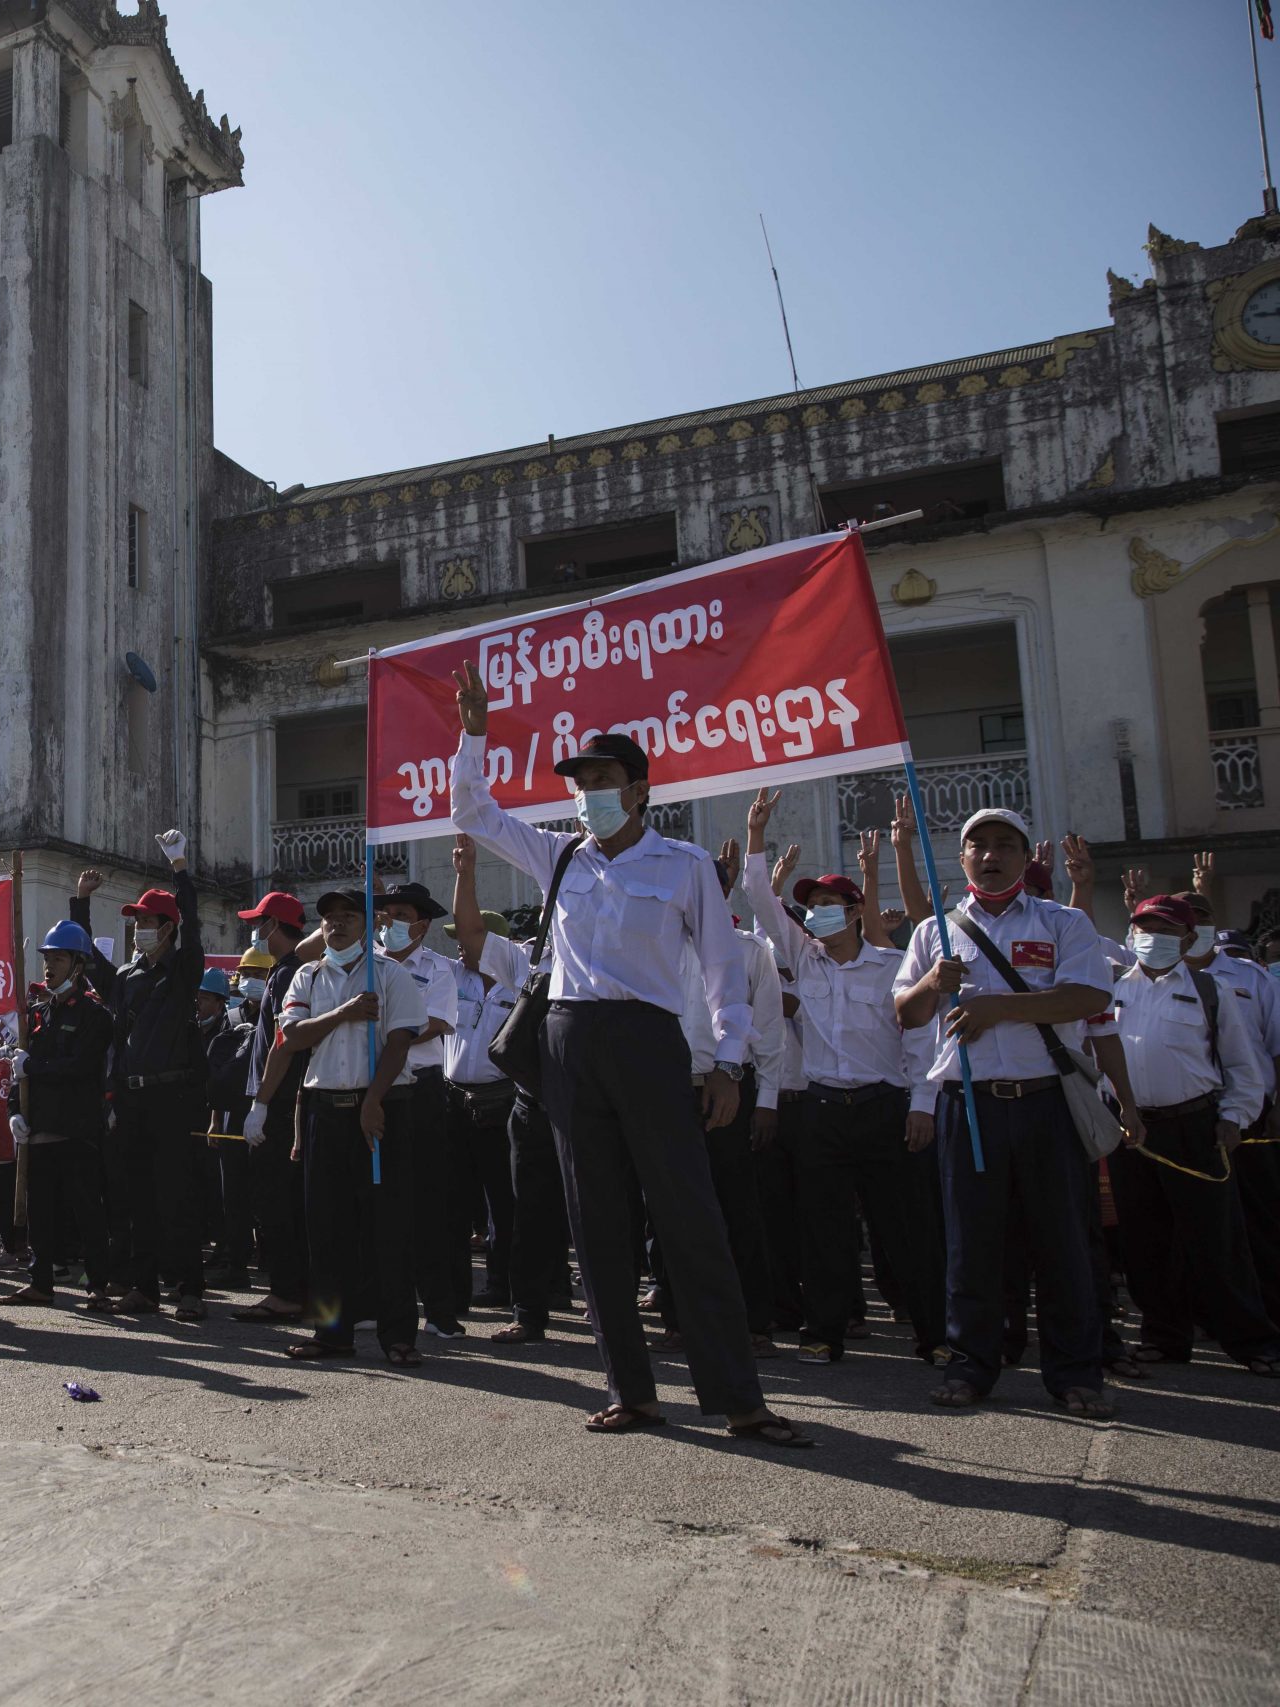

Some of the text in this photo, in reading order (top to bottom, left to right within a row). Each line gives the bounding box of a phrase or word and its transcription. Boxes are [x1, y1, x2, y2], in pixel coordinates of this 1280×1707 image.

[479, 599, 724, 712] မြန်မာ့မီးရထား
